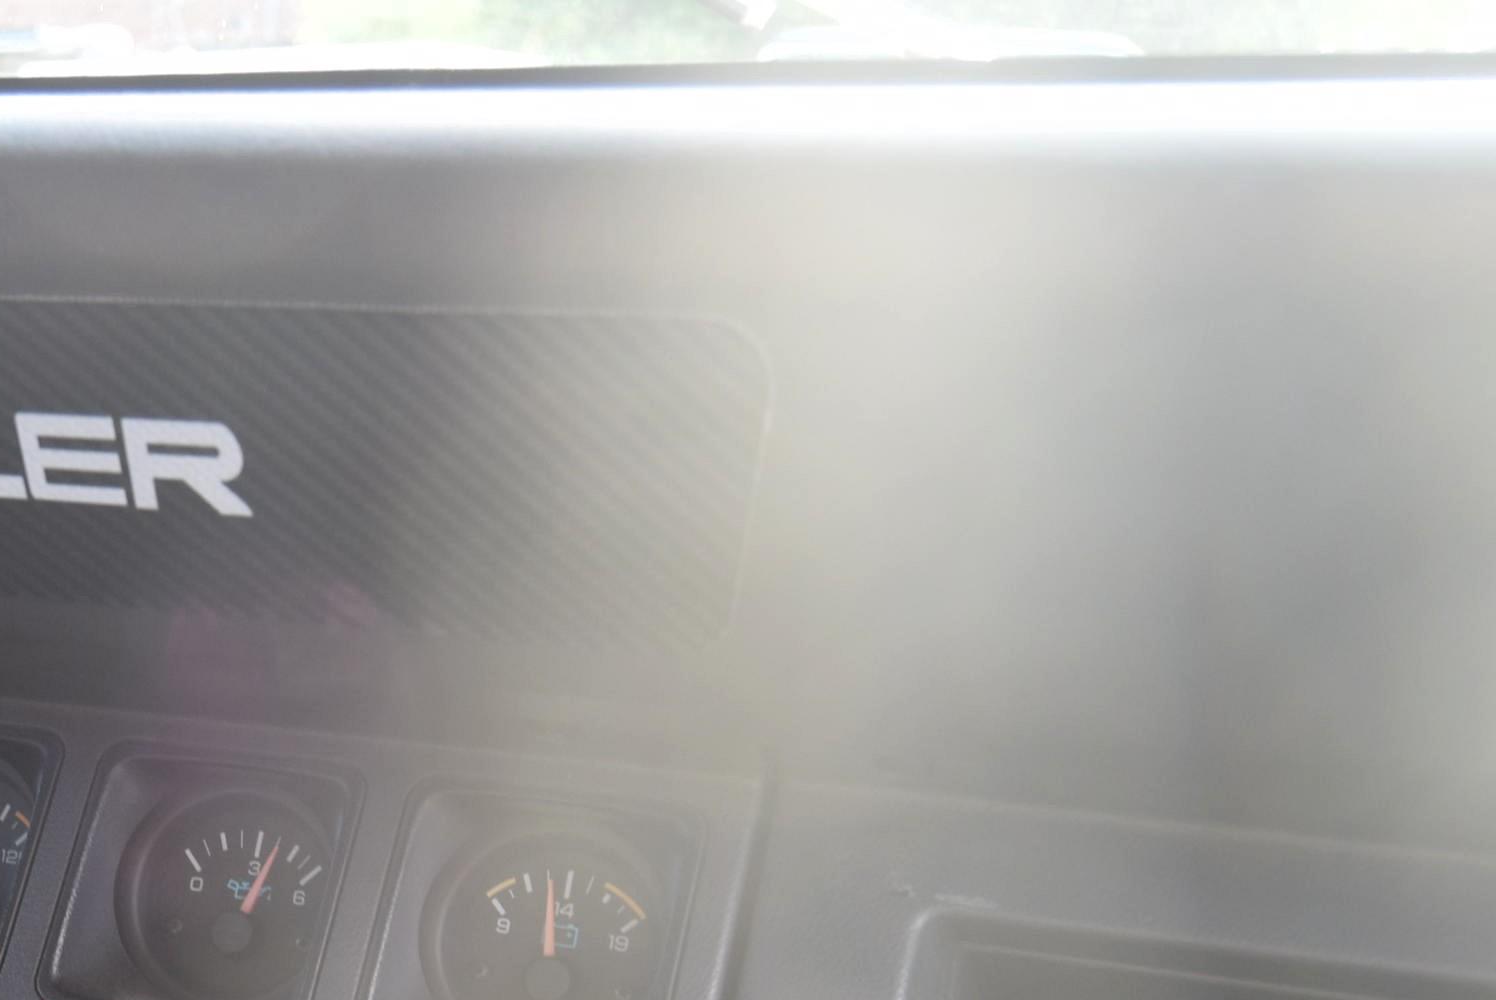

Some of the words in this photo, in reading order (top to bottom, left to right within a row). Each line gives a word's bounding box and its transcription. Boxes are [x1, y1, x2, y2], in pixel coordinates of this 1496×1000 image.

[247, 861, 262, 876] 3
[189, 876, 204, 892] 0
[292, 890, 306, 906] 6
[554, 901, 575, 918] 14
[495, 918, 511, 935] 9
[608, 935, 630, 952] 19
